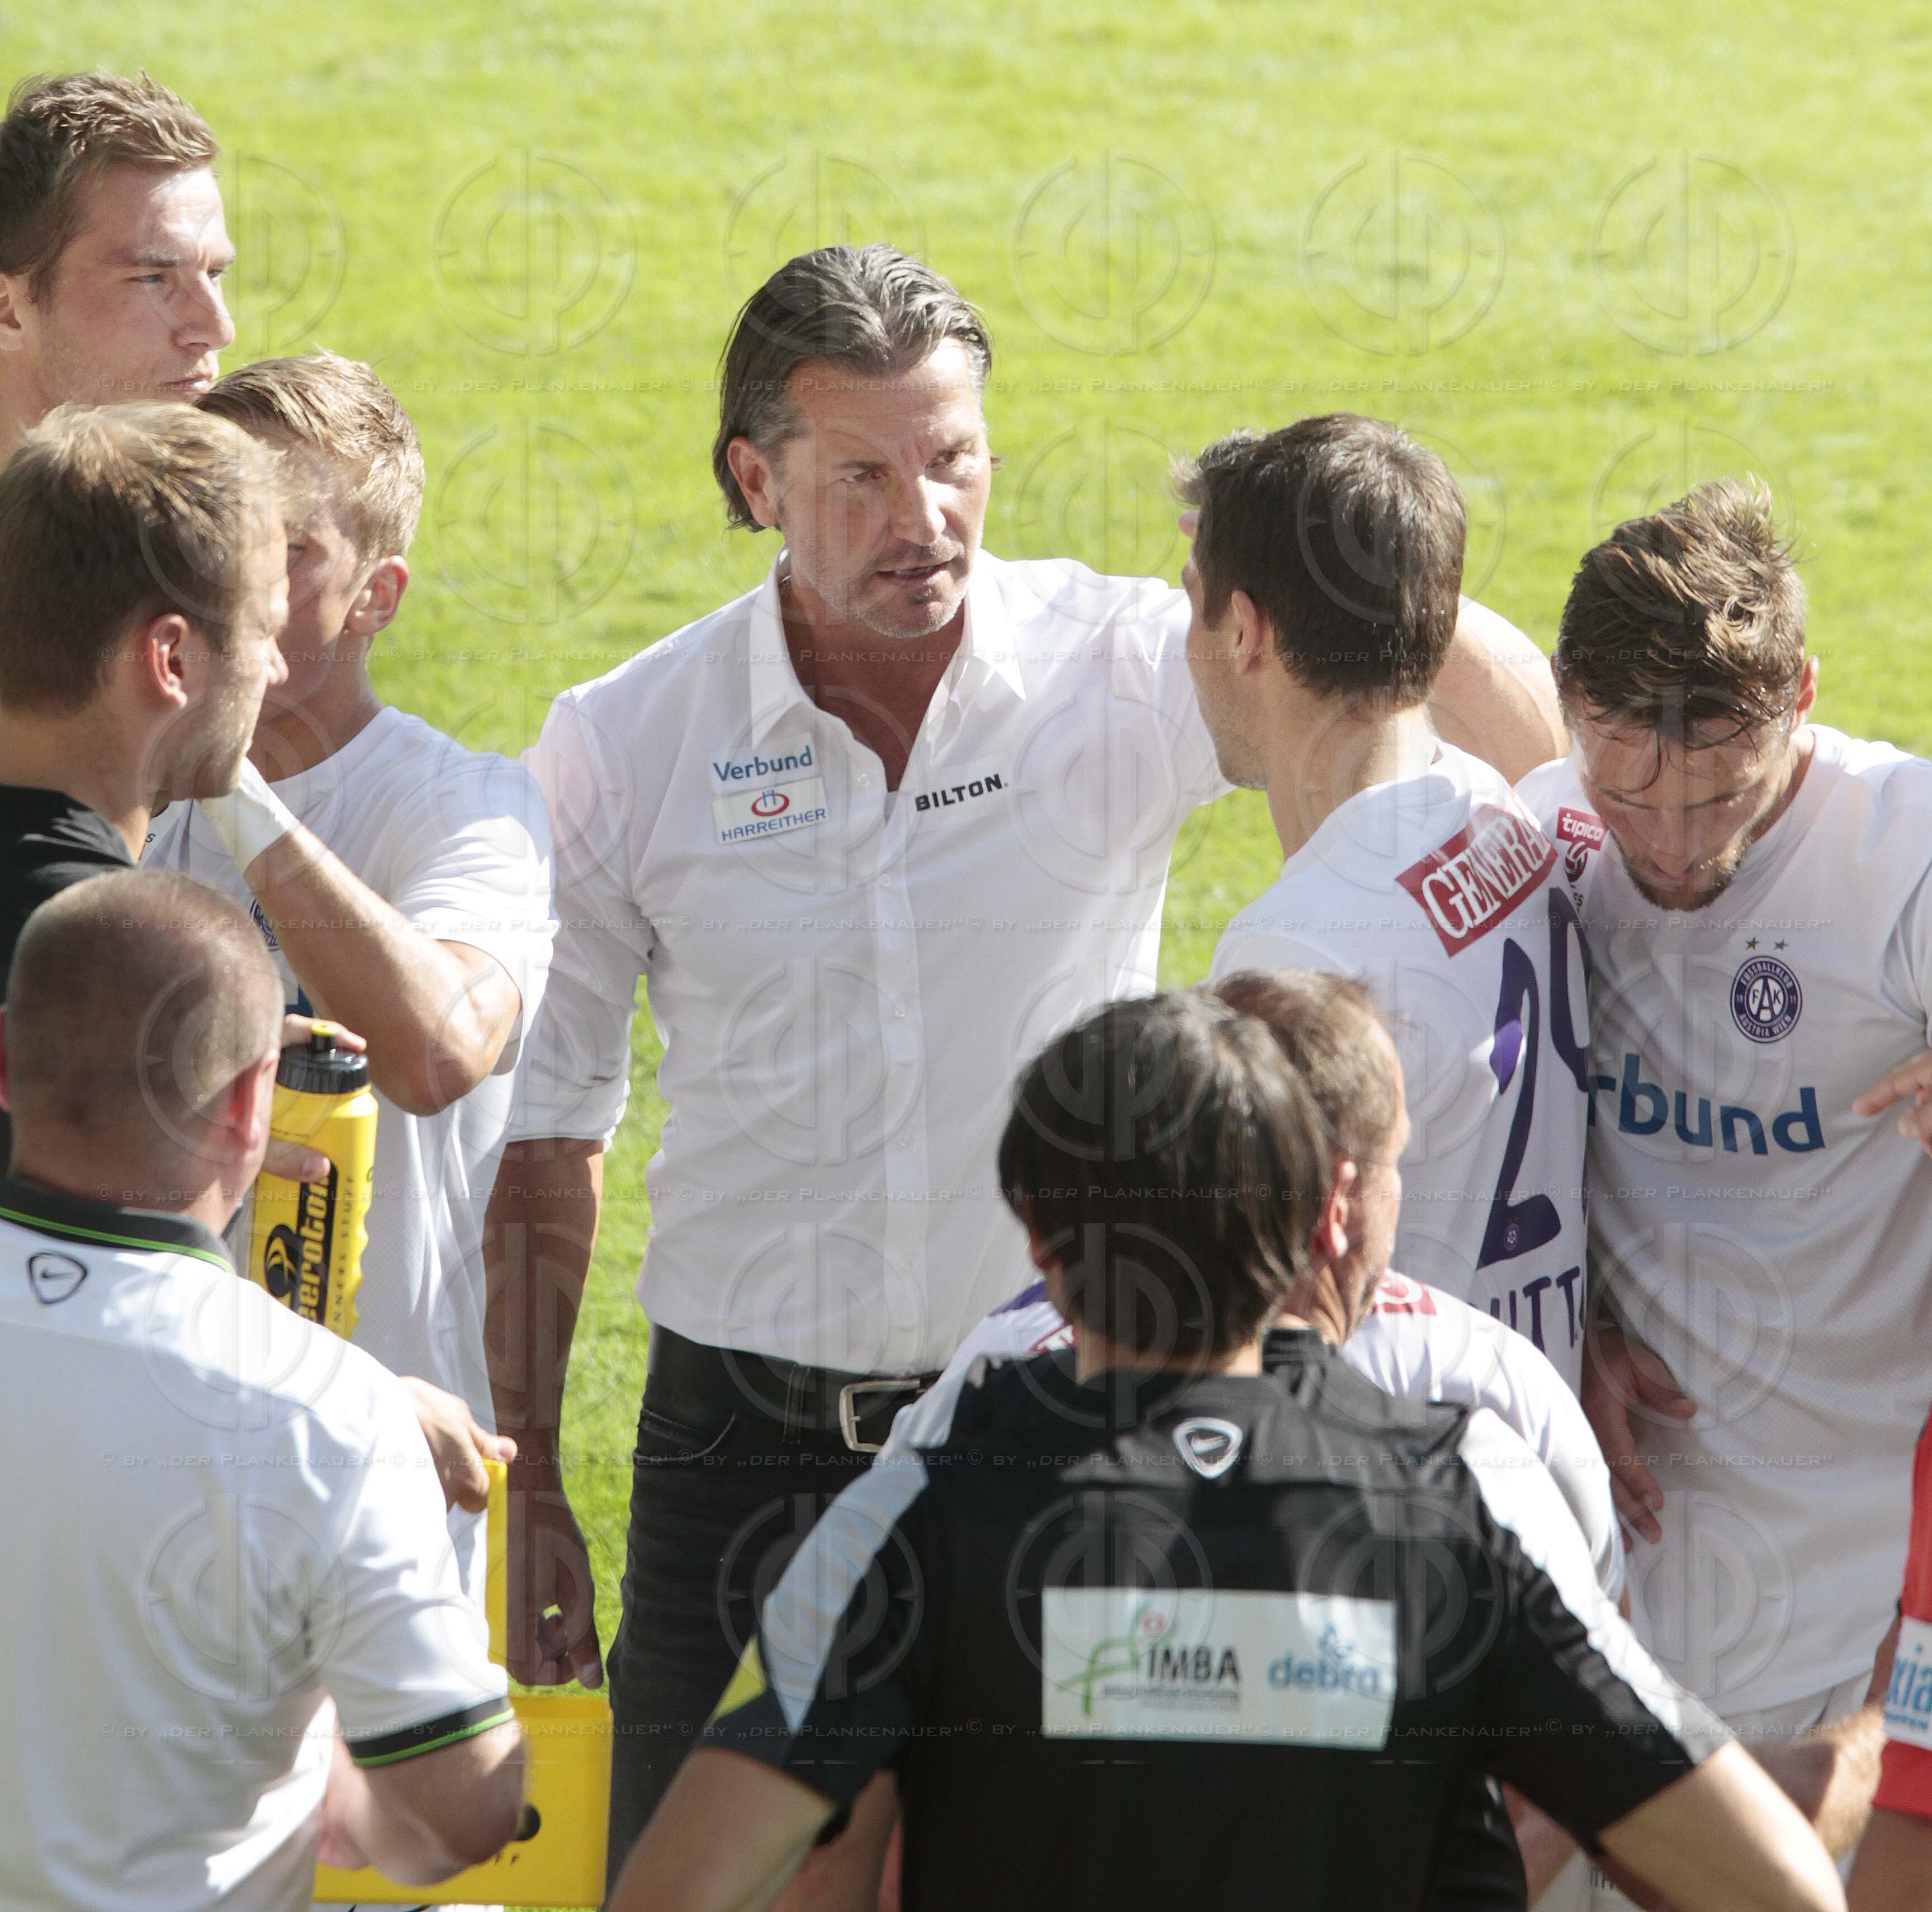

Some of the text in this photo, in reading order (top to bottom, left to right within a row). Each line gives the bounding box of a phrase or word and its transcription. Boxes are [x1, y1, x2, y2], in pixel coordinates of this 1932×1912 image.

[713, 745, 812, 782] Verbund
[721, 808, 826, 841] HARREITHER
[1562, 812, 1603, 840] tipico
[1268, 1651, 1380, 1693] debra
